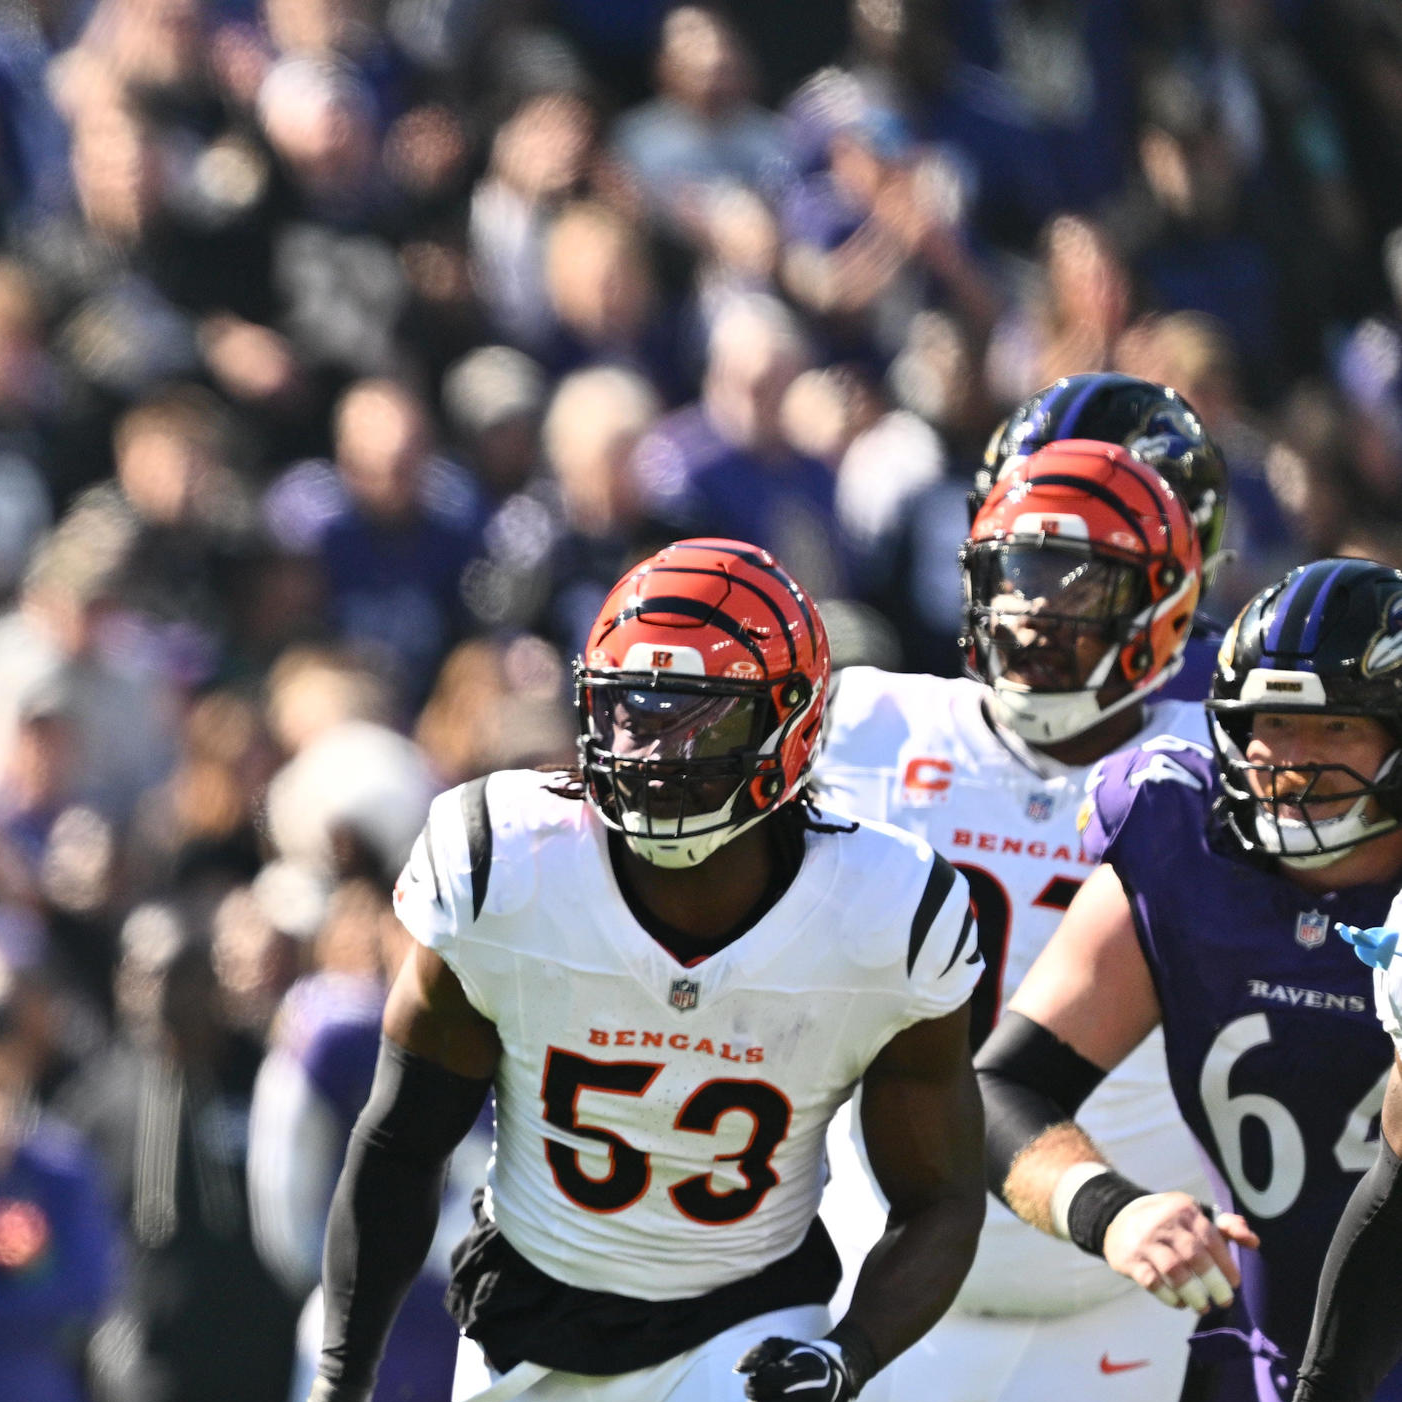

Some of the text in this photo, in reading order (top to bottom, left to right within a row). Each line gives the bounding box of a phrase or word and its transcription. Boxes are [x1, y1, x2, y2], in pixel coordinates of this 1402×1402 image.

[903, 757, 954, 792] C
[953, 828, 1097, 866] BENGAL
[1248, 979, 1366, 1012] RAVENS
[588, 1028, 765, 1064] BENGALS
[540, 1045, 794, 1226] 53
